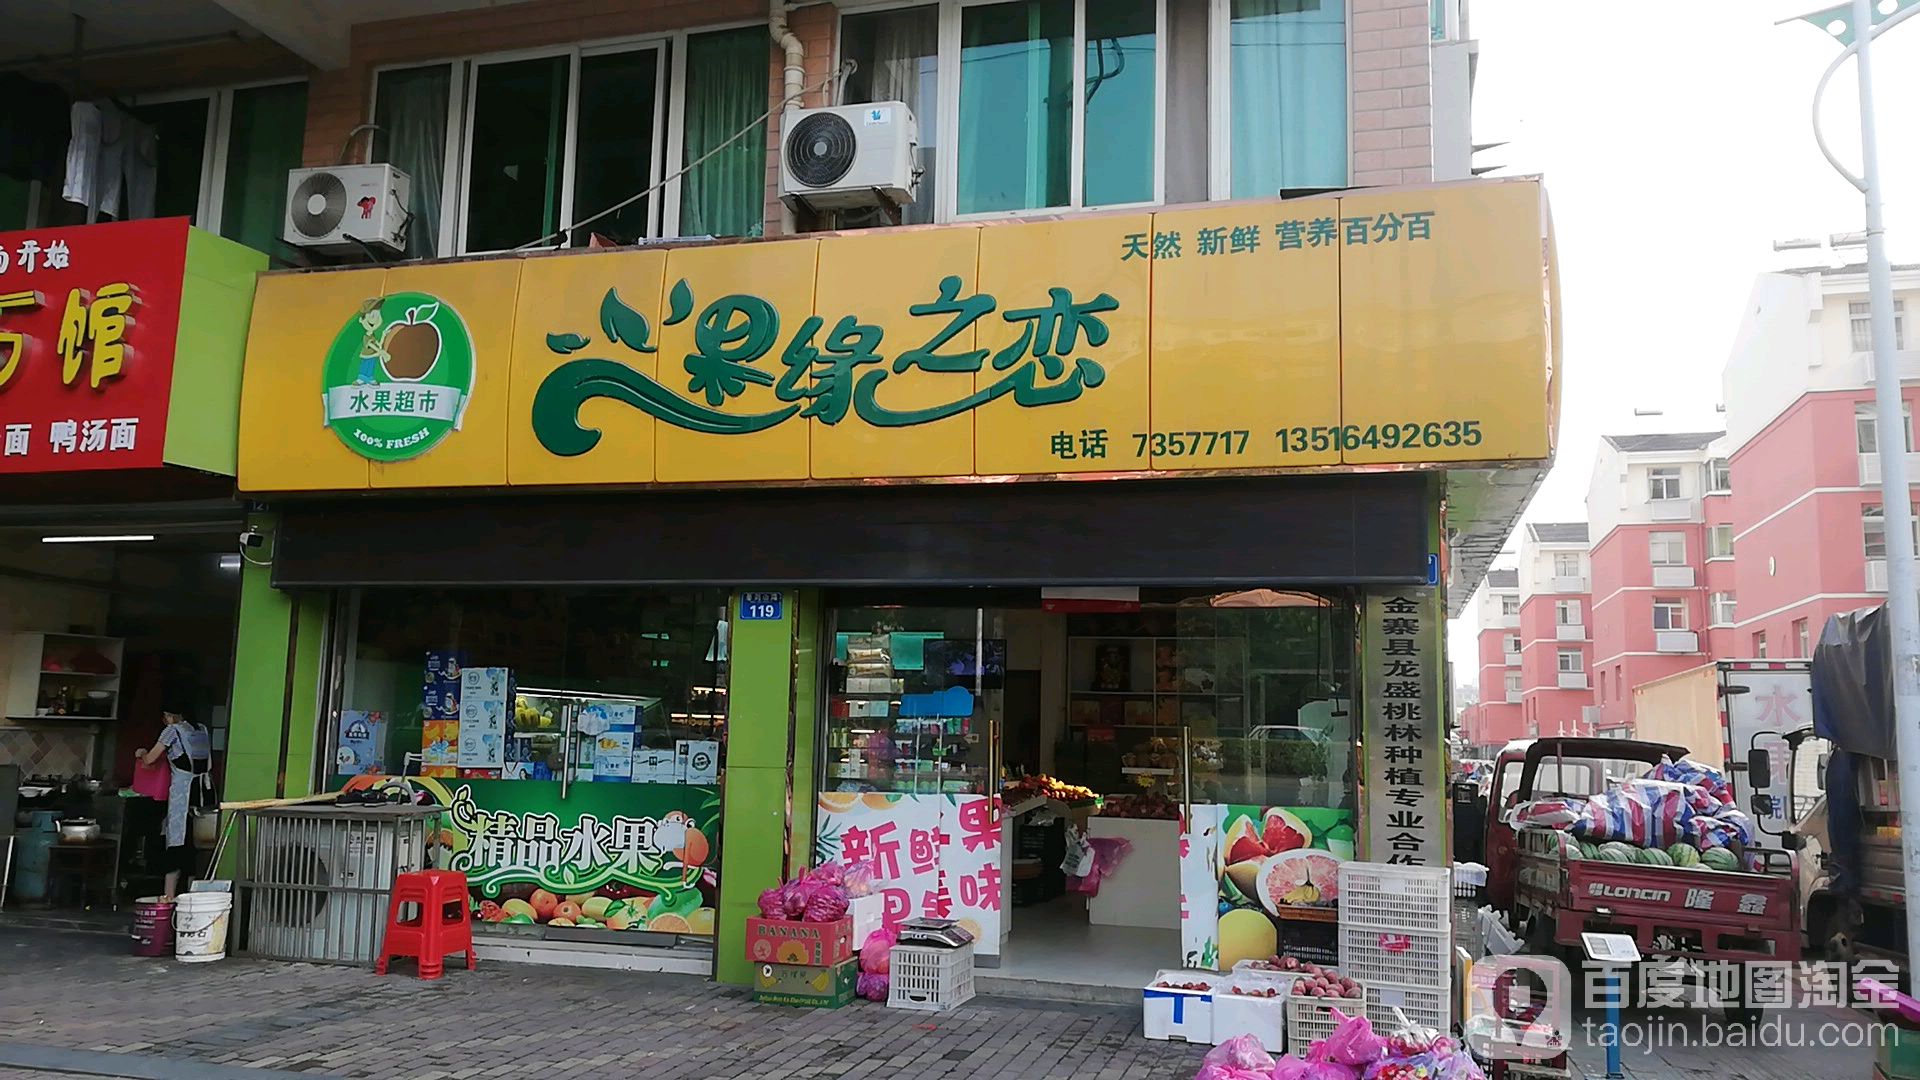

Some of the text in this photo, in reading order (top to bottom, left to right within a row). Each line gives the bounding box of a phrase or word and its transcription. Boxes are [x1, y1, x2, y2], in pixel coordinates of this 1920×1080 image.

[1121, 211, 1435, 261] 天然 新鲜 营养百分百
[683, 275, 1120, 428] 果缘之恋
[350, 389, 439, 413] 水果超市
[50, 418, 139, 453] 鸭汤面
[353, 427, 430, 449] 100% FRESH
[1051, 421, 1482, 460] 电话 7357717 13516492635
[750, 604, 774, 618] 119
[468, 811, 660, 874] 精品水果
[758, 924, 820, 939] BANANA
